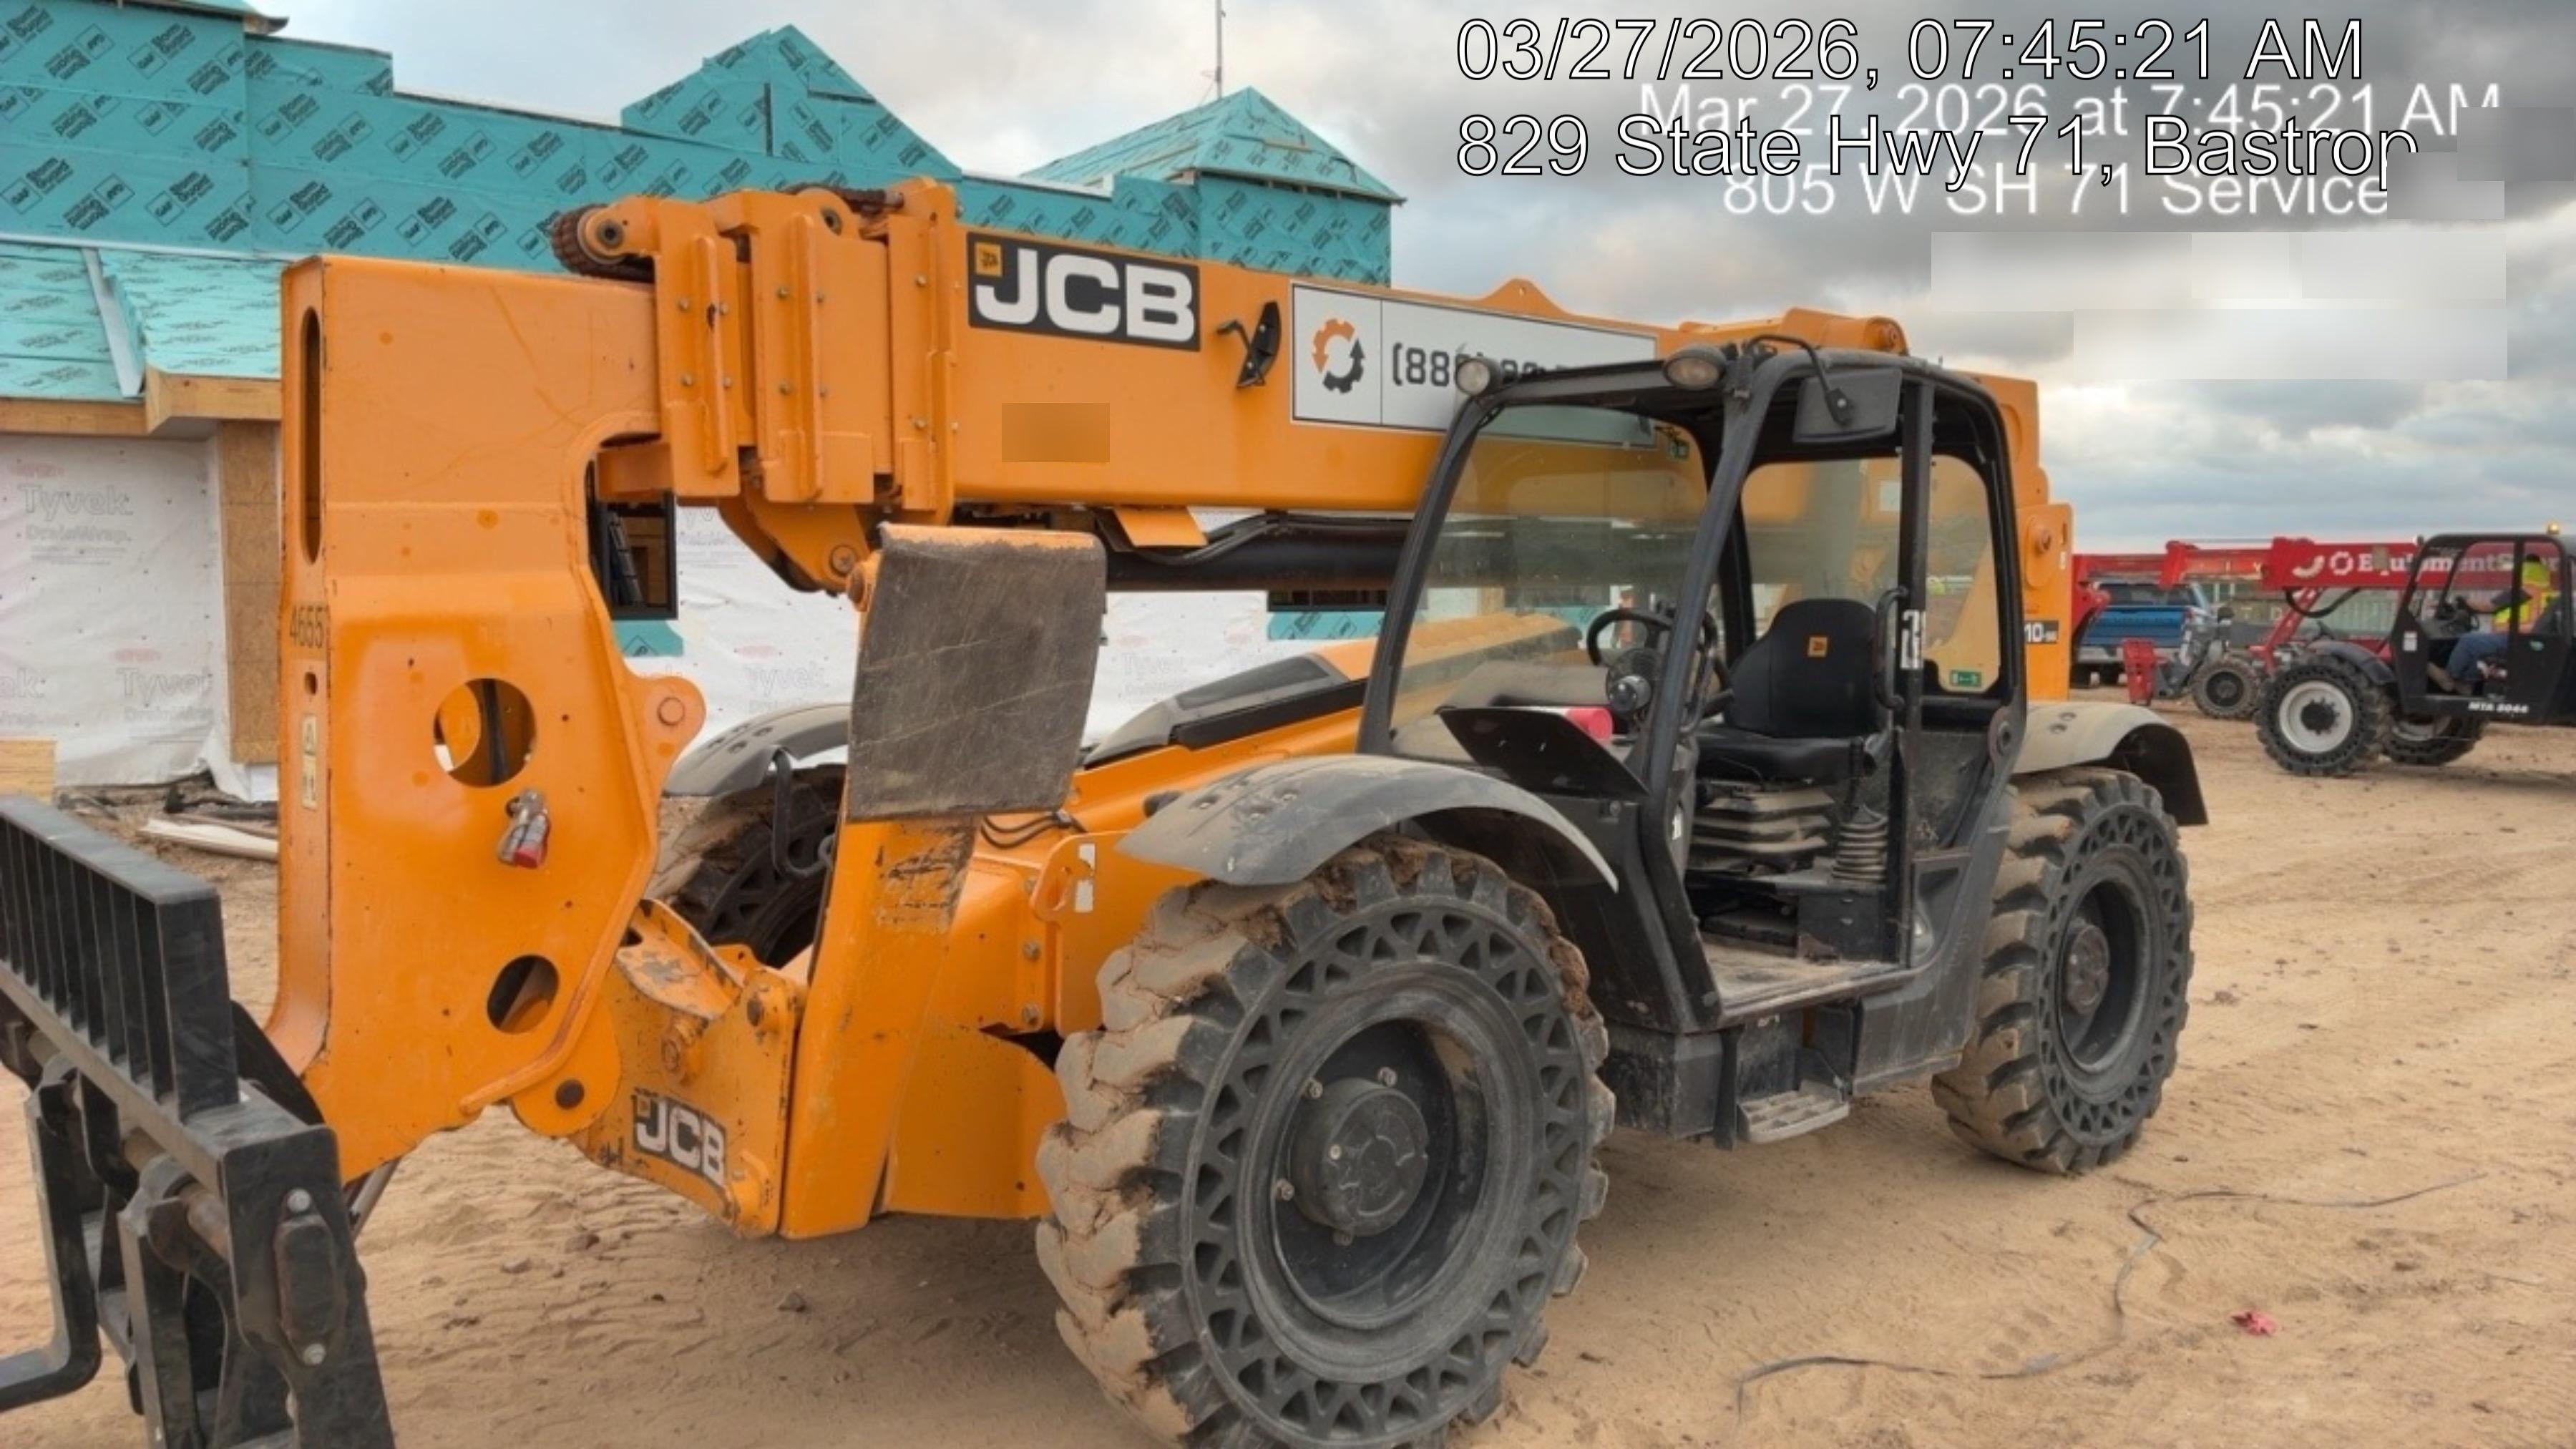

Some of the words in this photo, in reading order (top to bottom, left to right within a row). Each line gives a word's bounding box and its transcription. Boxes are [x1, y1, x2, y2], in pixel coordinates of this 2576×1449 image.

[976, 248, 1195, 342] JCB
[17, 484, 134, 522] Tyvek
[635, 1096, 726, 1188] JCB
